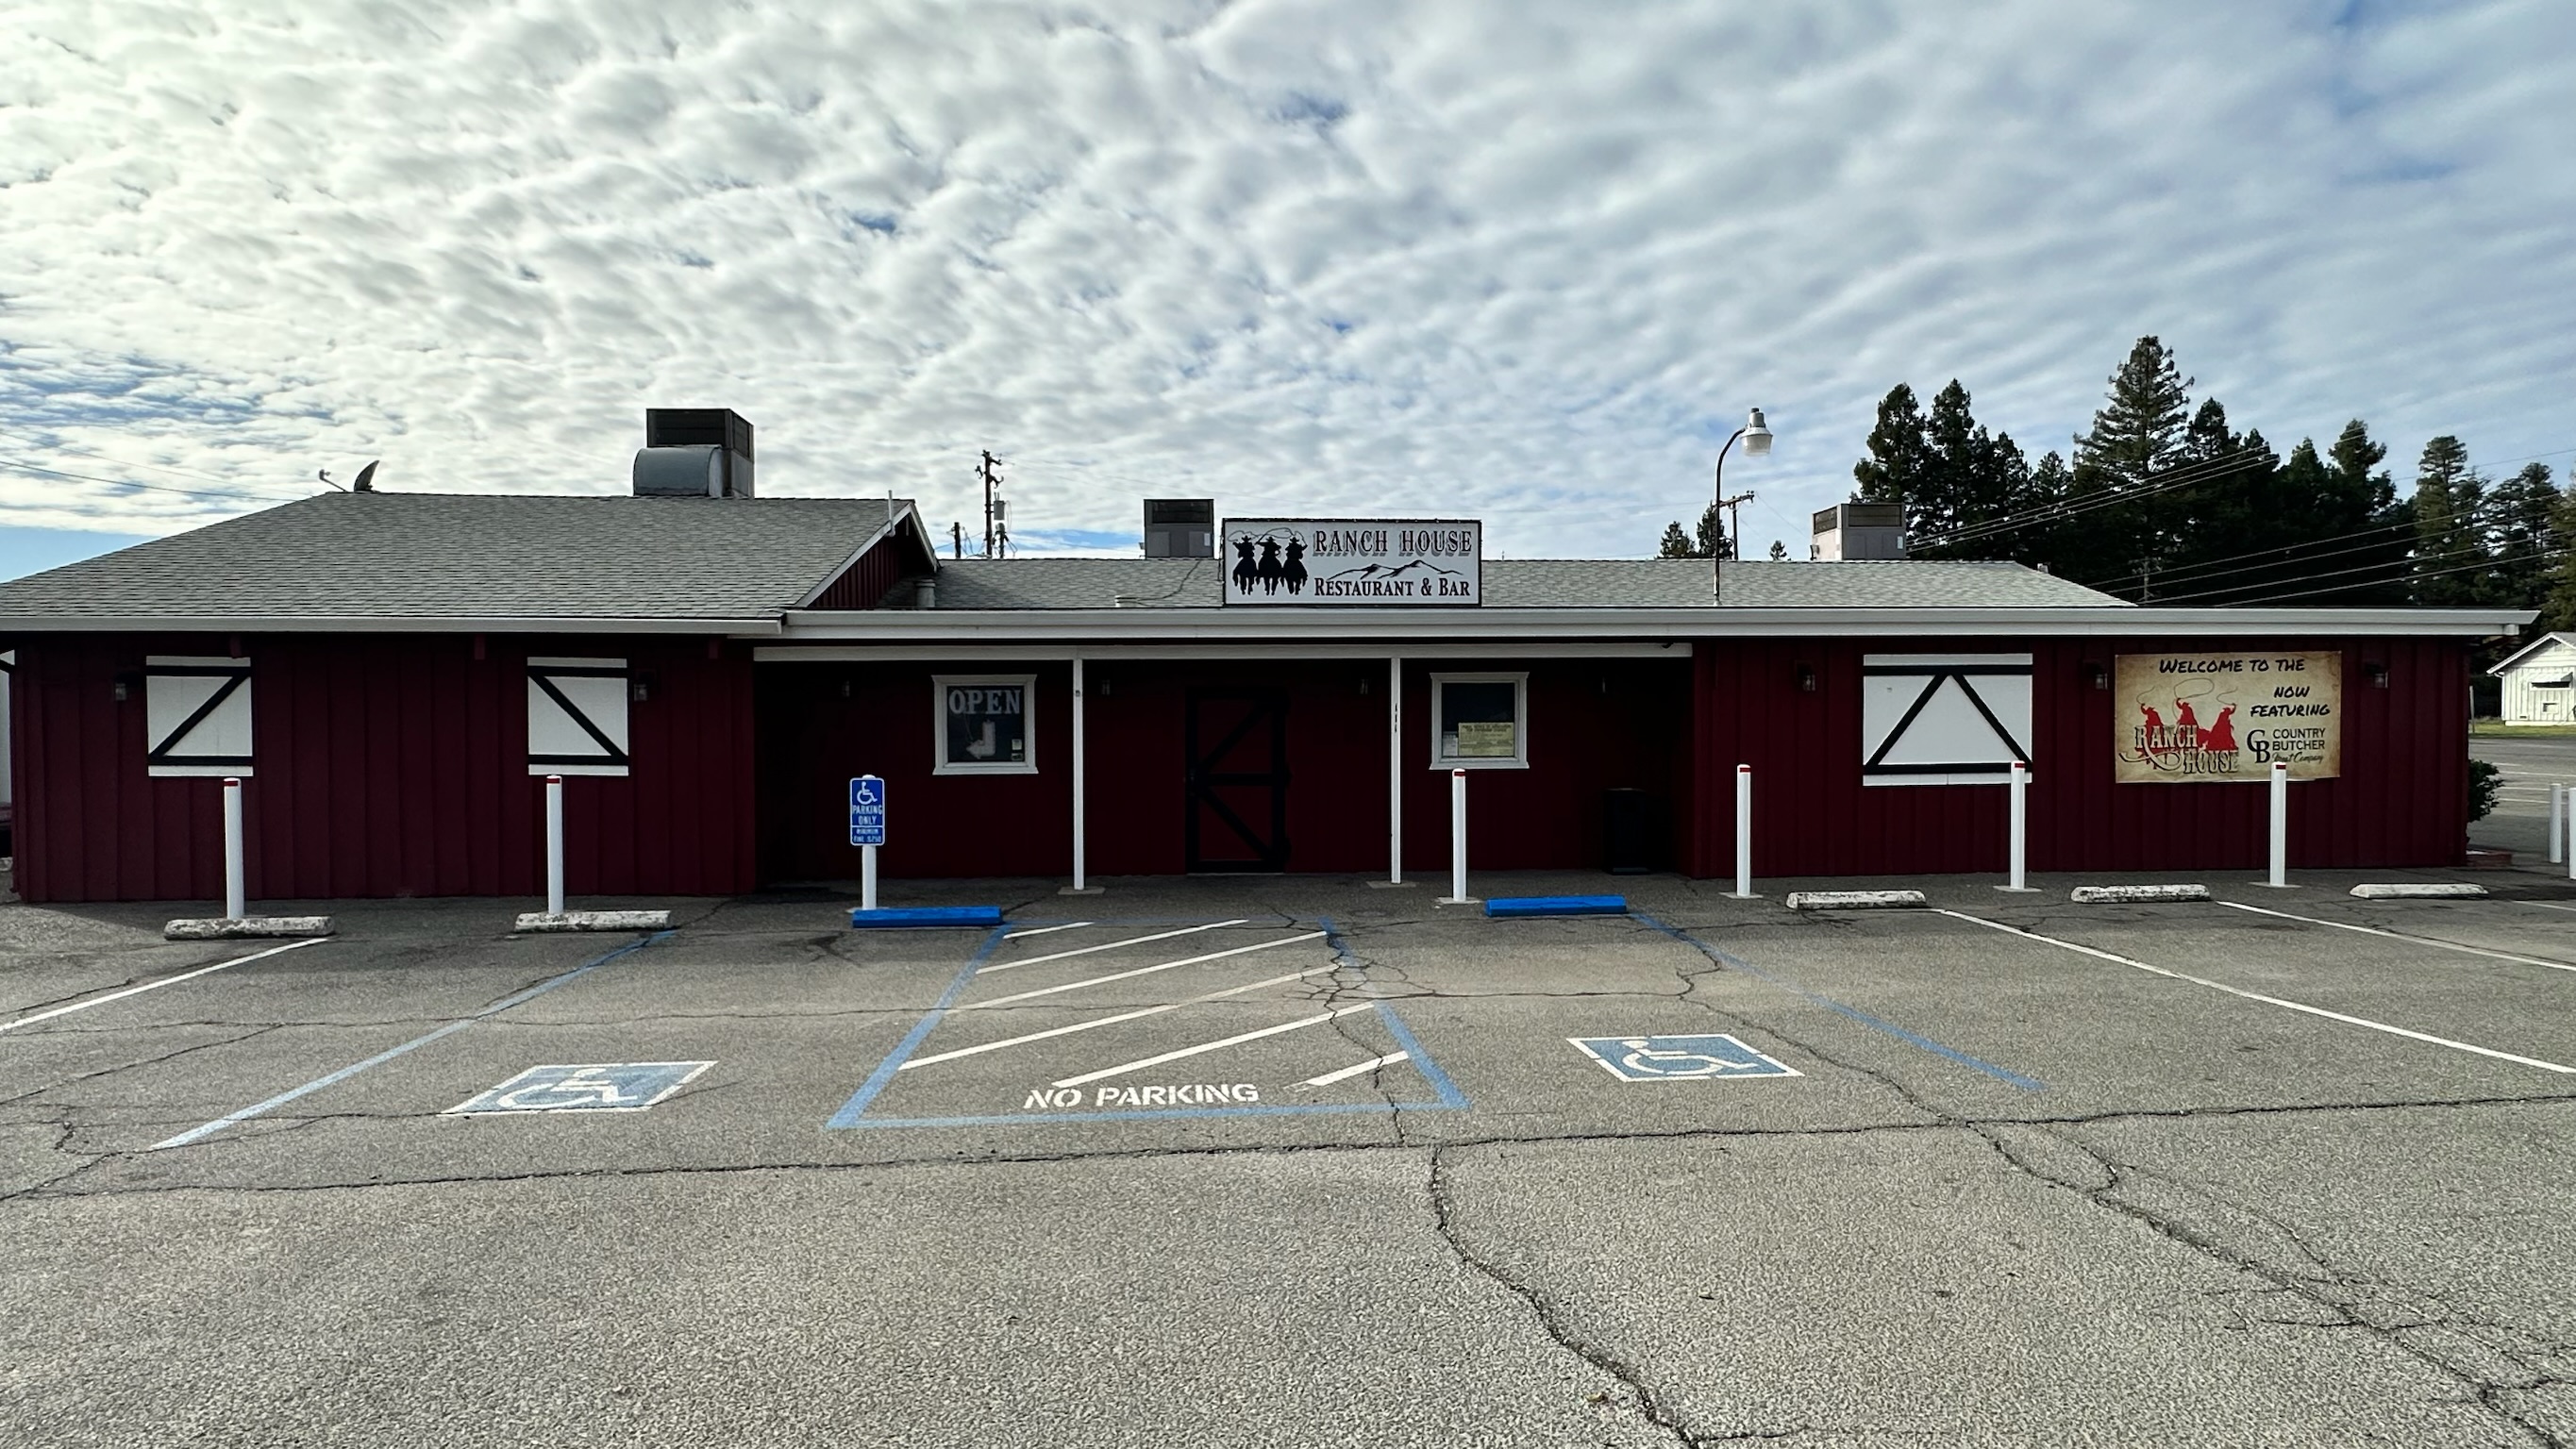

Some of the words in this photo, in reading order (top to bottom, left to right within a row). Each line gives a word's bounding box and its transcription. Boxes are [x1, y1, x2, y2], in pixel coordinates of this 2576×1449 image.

[1313, 530, 1388, 556] RANCH
[1399, 530, 1473, 557] HOUSE
[1314, 577, 1413, 596] RESTAURANT
[1420, 577, 1432, 596] &
[1438, 577, 1470, 596] BAR
[2159, 658, 2243, 674] WELCOME
[2250, 659, 2269, 672] TO
[2276, 658, 2305, 672] THE
[2273, 686, 2310, 698] NOW
[948, 690, 1021, 714] OPEN
[2250, 704, 2332, 717] FEATURING
[2134, 724, 2199, 751] RANCH
[2272, 727, 2326, 739] COUNTRY
[2272, 740, 2325, 751] BUTCHER
[2183, 747, 2240, 774] HOUSE
[852, 805, 882, 815] PARKING
[858, 815, 878, 825] ONLY
[1023, 1089, 1082, 1109] NO
[1095, 1084, 1259, 1107] PARKING
